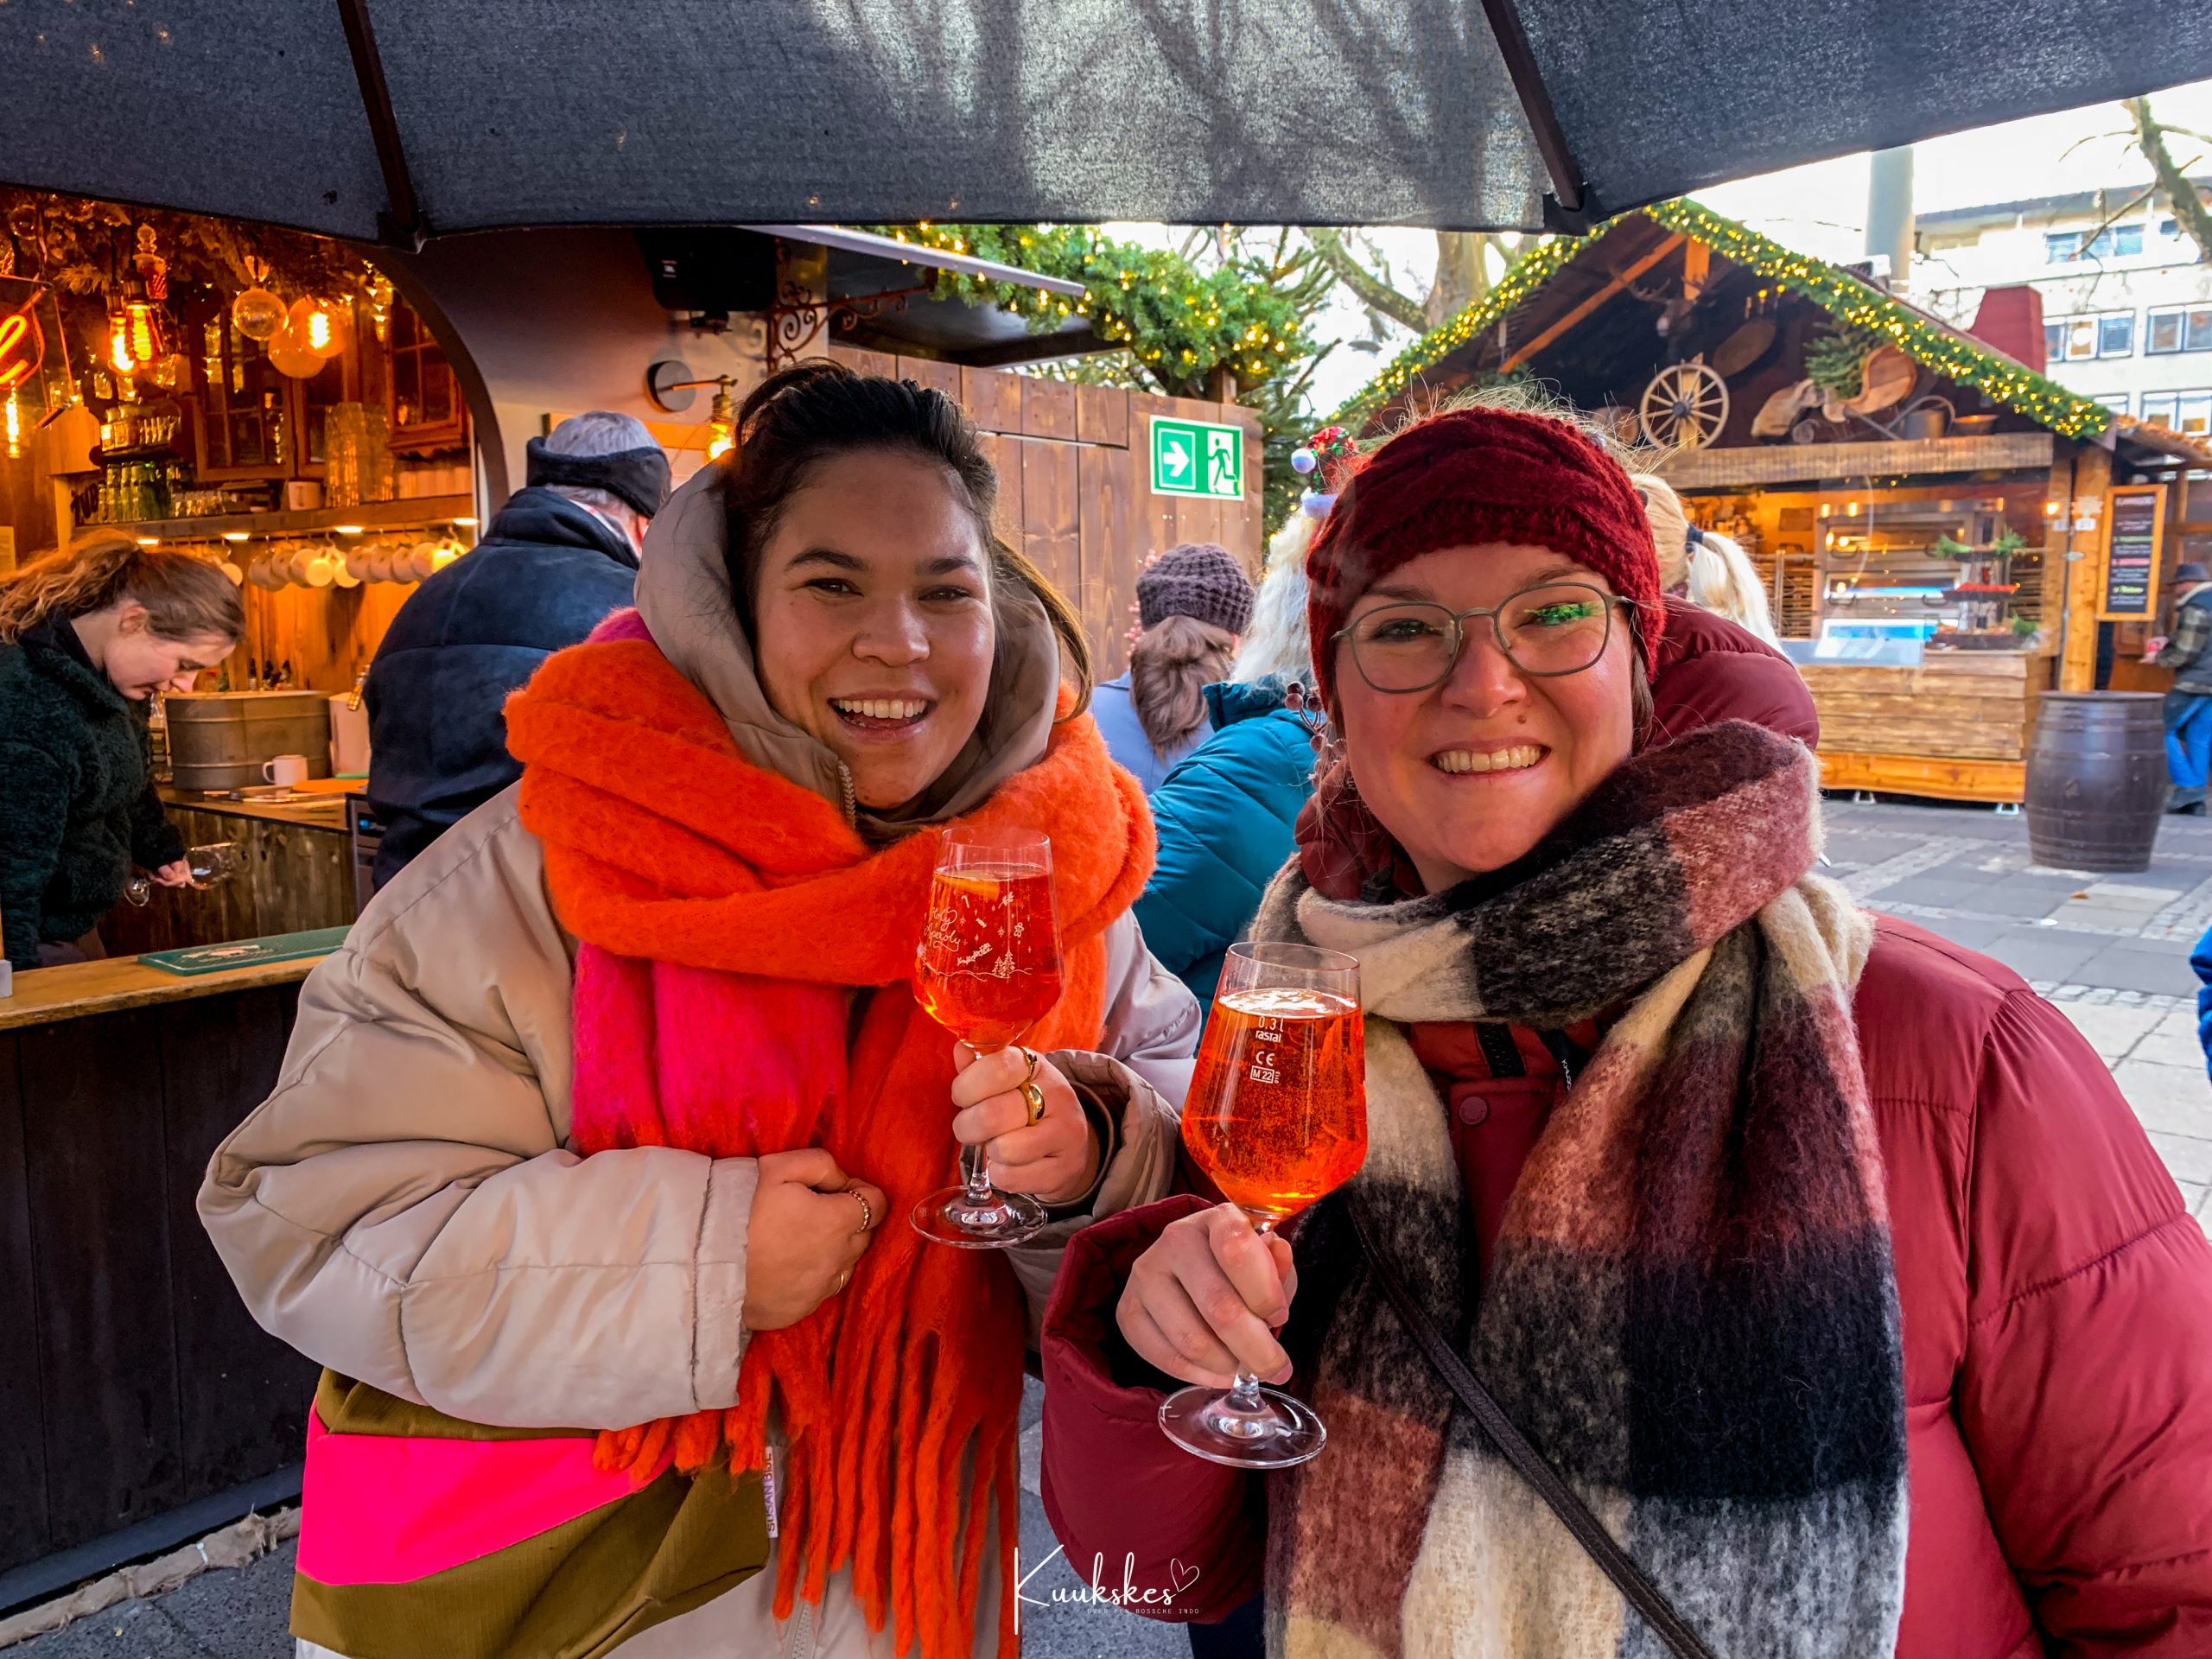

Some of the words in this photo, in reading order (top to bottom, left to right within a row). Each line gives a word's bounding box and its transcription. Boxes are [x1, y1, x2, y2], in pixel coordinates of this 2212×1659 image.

[1255, 1030, 1282, 1043] rastal
[1252, 1068, 1262, 1079] M
[1262, 1071, 1273, 1081] 22
[764, 1485, 776, 1532] SUSAN
